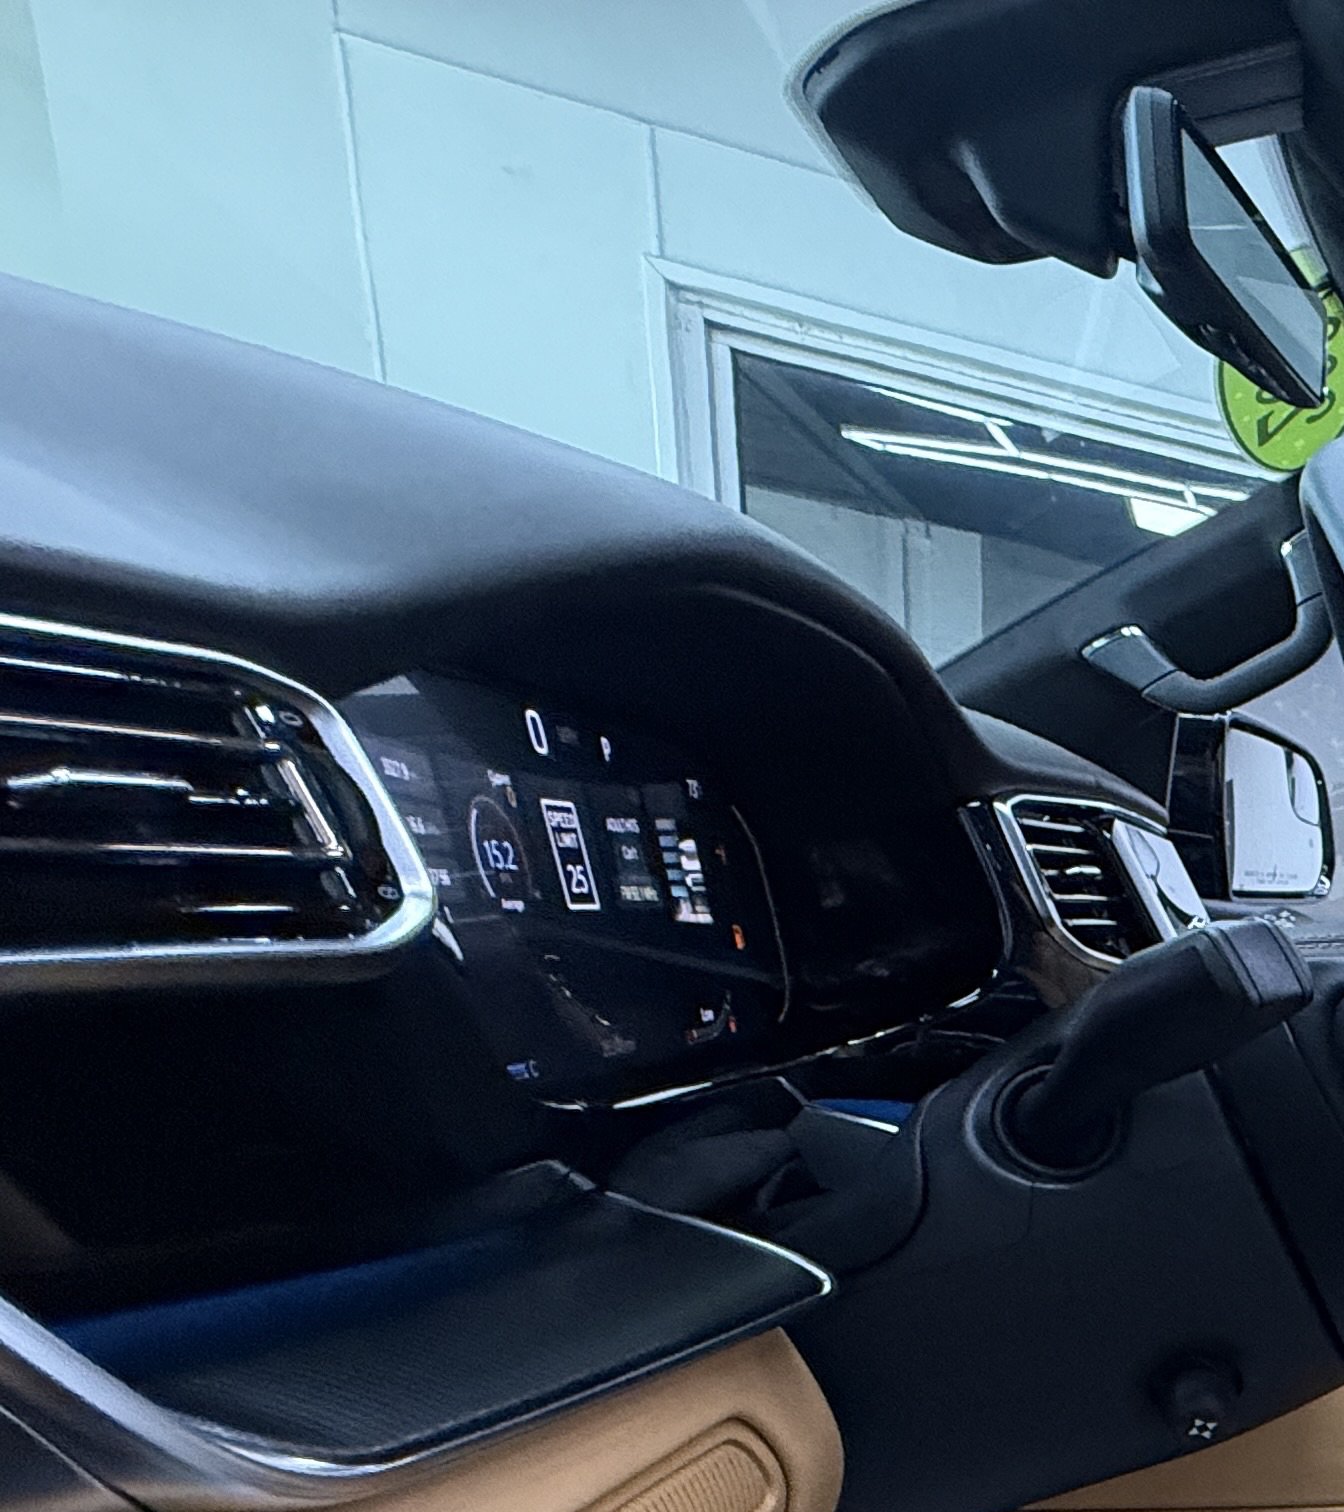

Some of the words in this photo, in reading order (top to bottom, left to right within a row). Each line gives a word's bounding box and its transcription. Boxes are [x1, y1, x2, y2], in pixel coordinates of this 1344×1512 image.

[524, 708, 549, 756] 0
[547, 810, 577, 829] SPEED
[566, 864, 589, 894] 25
